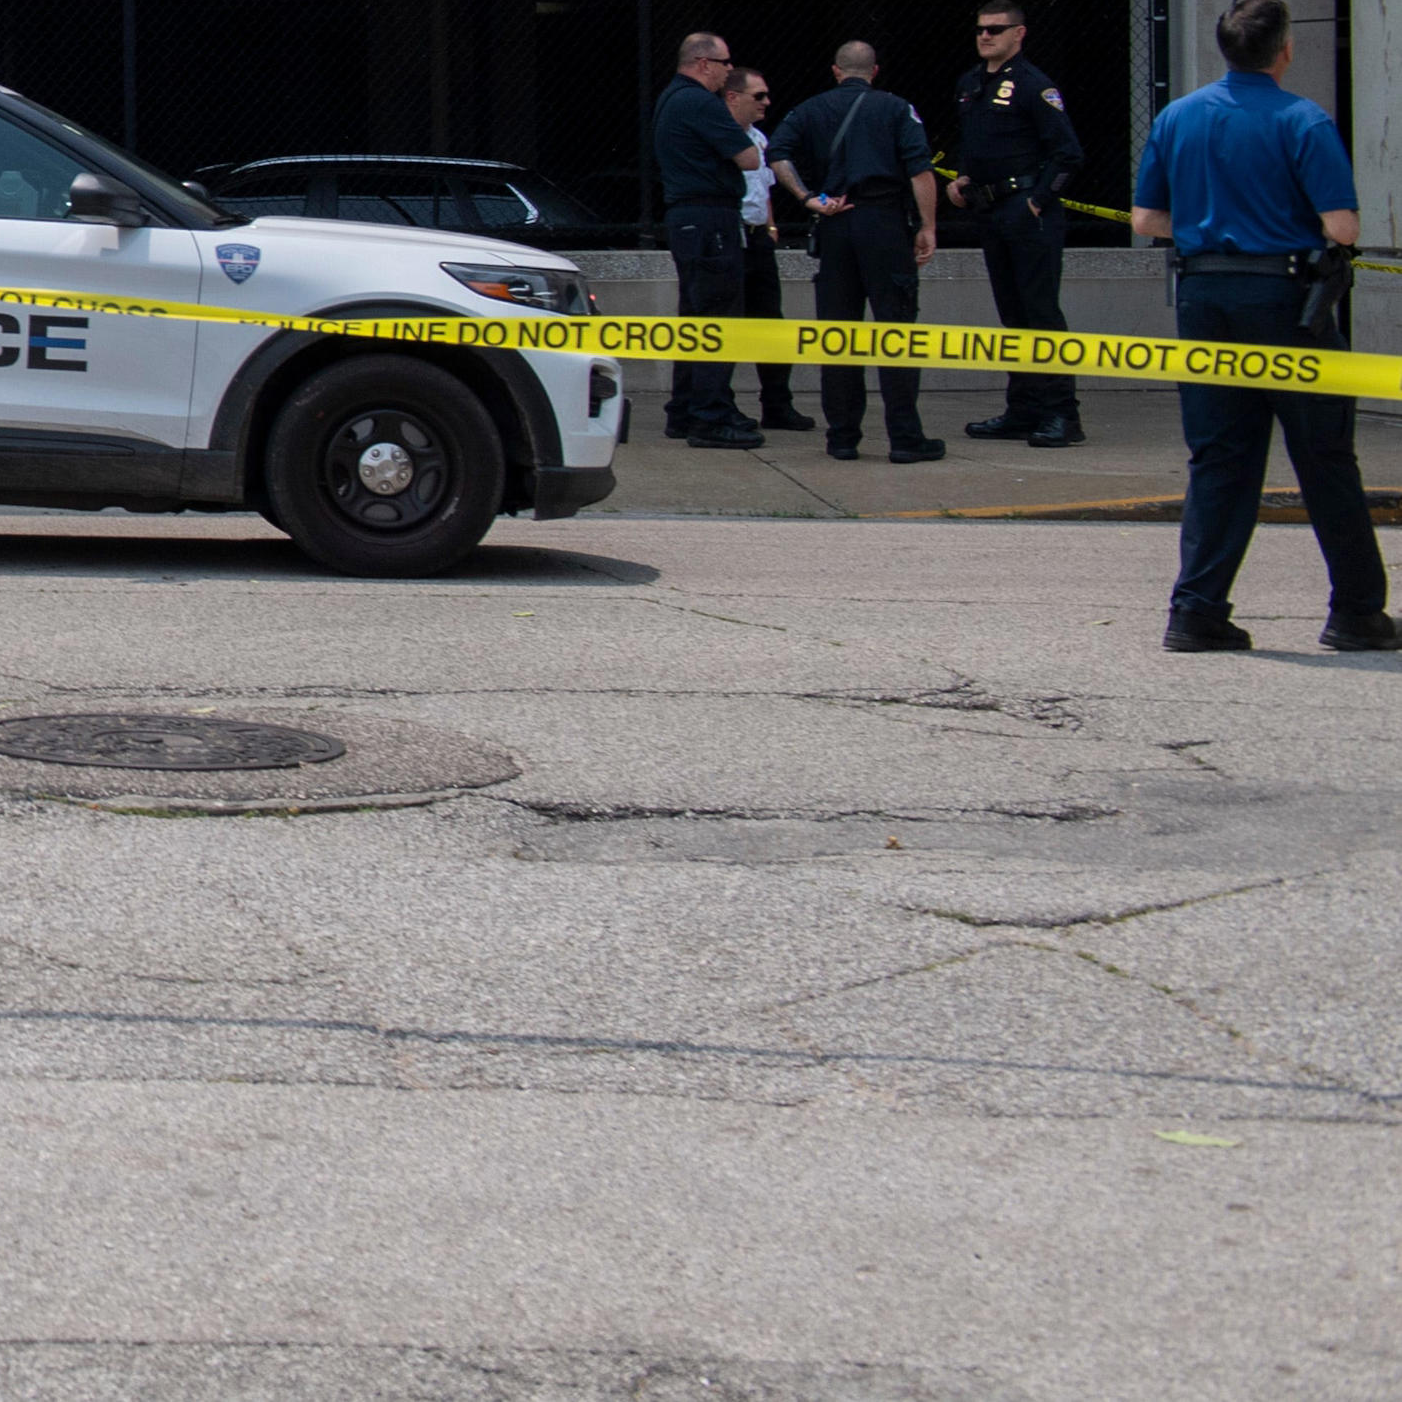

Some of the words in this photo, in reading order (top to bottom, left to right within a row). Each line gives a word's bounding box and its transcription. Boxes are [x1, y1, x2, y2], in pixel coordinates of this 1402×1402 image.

[458, 321, 508, 346] DO
[518, 321, 591, 349] NOT
[599, 322, 723, 353] CROSS
[797, 326, 930, 358] POLICE
[940, 331, 1021, 363] LINE
[1032, 336, 1086, 366] DO
[1097, 340, 1177, 372] NOT
[1185, 346, 1322, 384] CROSS
